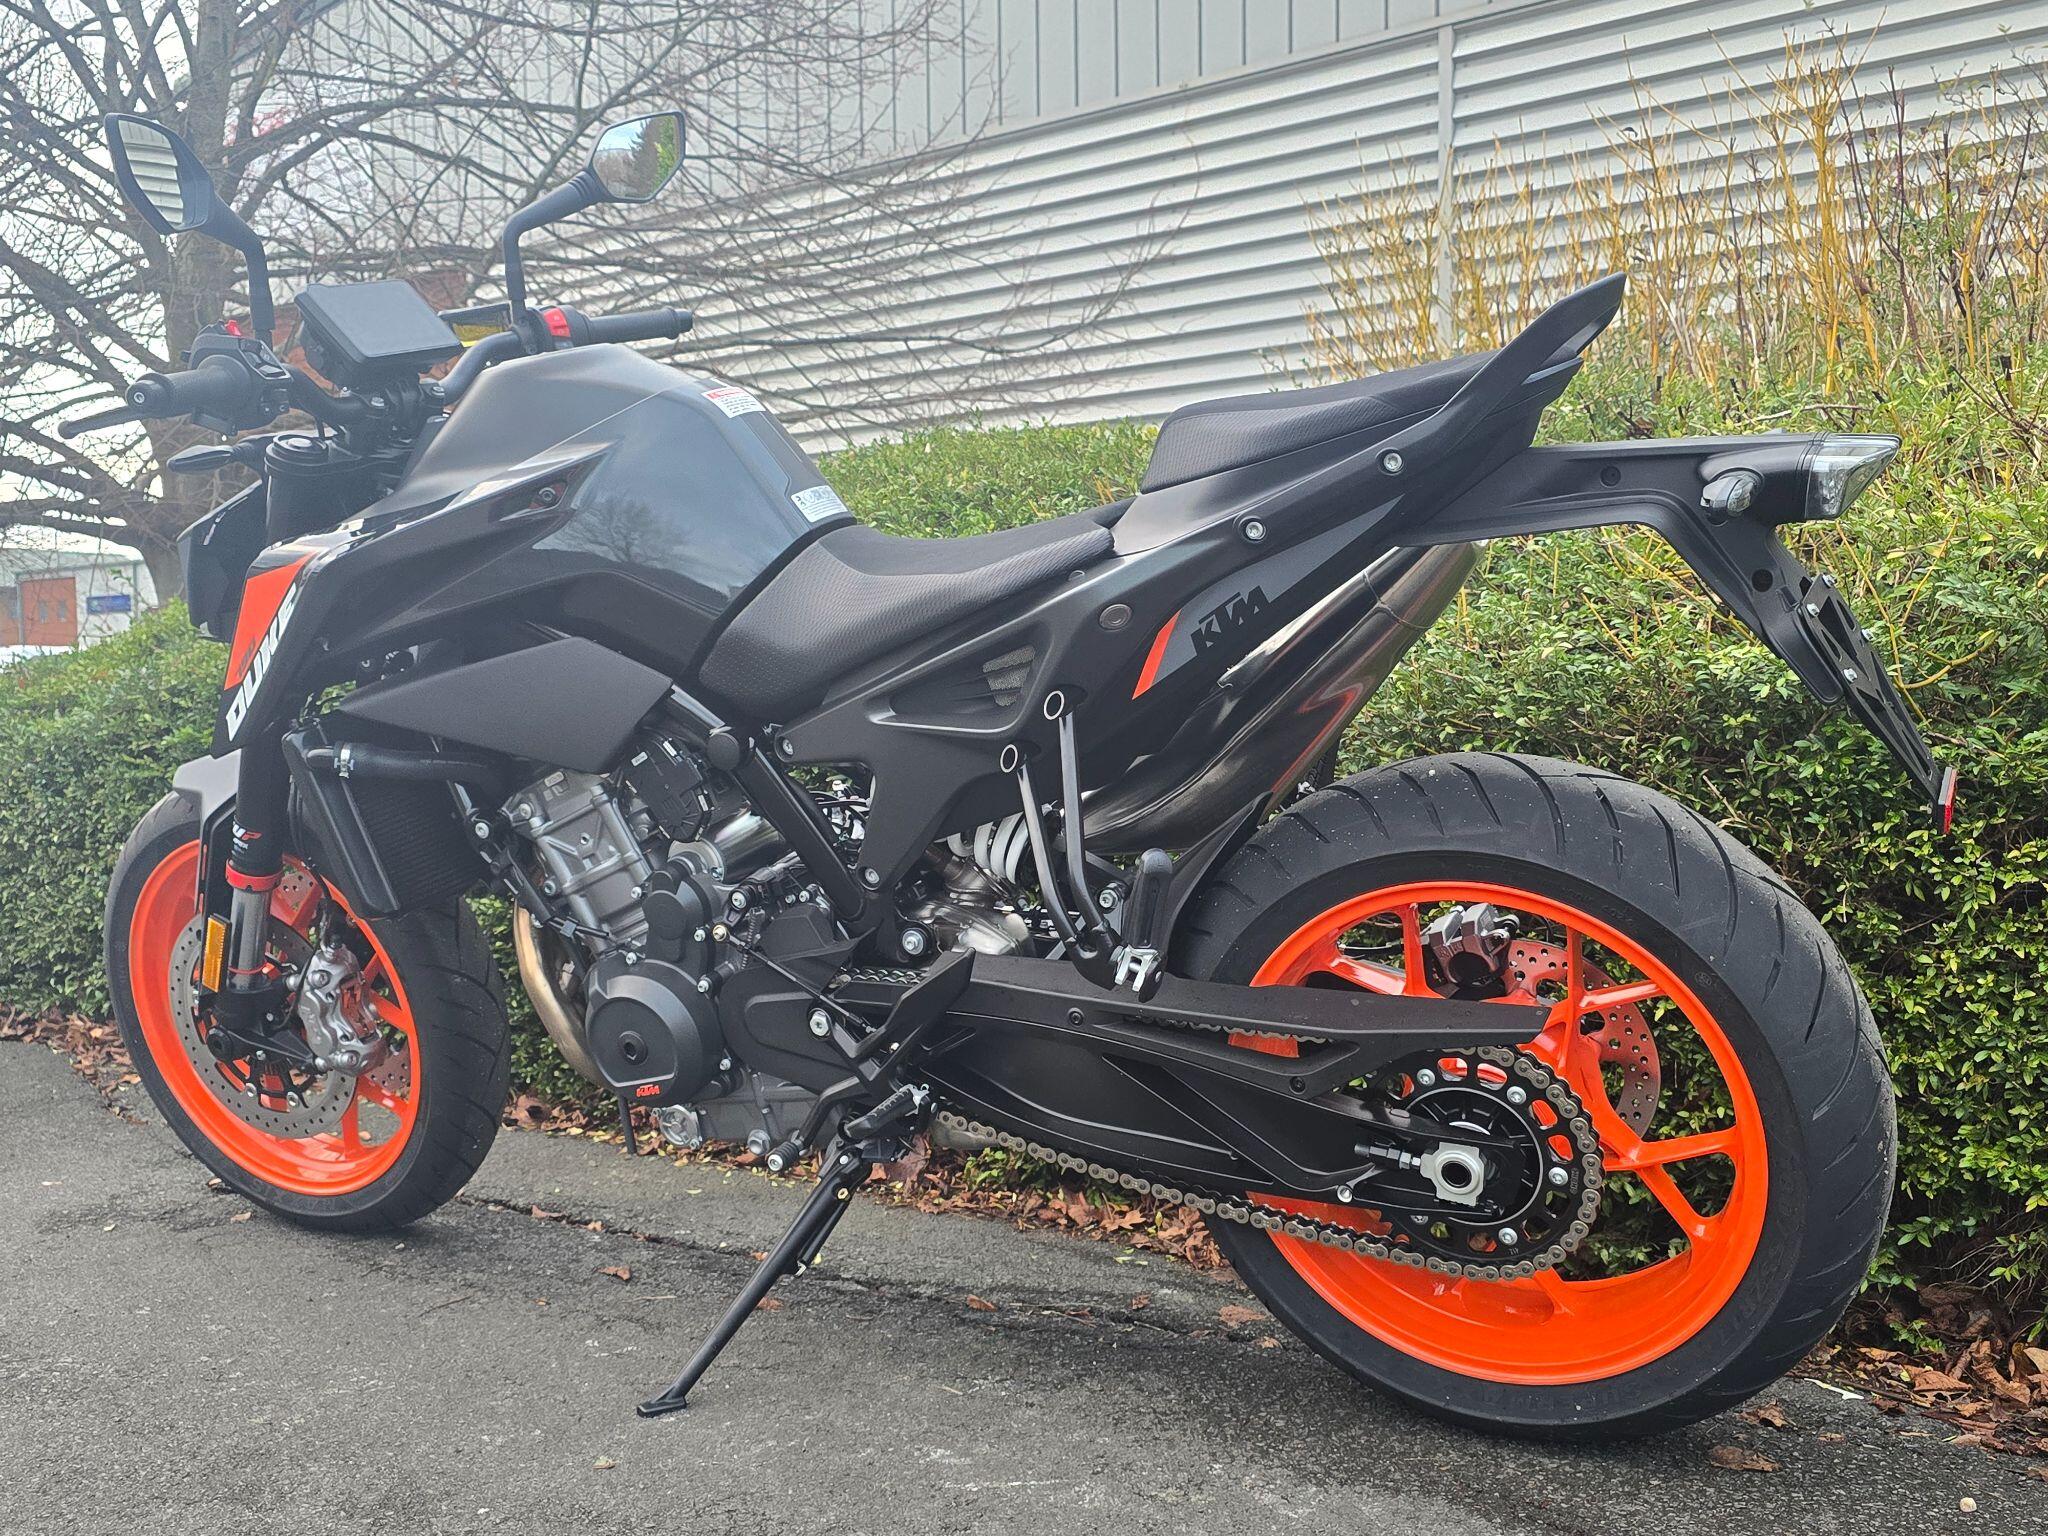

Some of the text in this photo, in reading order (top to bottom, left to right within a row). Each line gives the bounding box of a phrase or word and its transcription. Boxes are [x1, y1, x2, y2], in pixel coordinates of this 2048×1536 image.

[1190, 585, 1270, 656] KTM
[226, 582, 297, 742] DUKE
[636, 1084, 660, 1097] KTM
